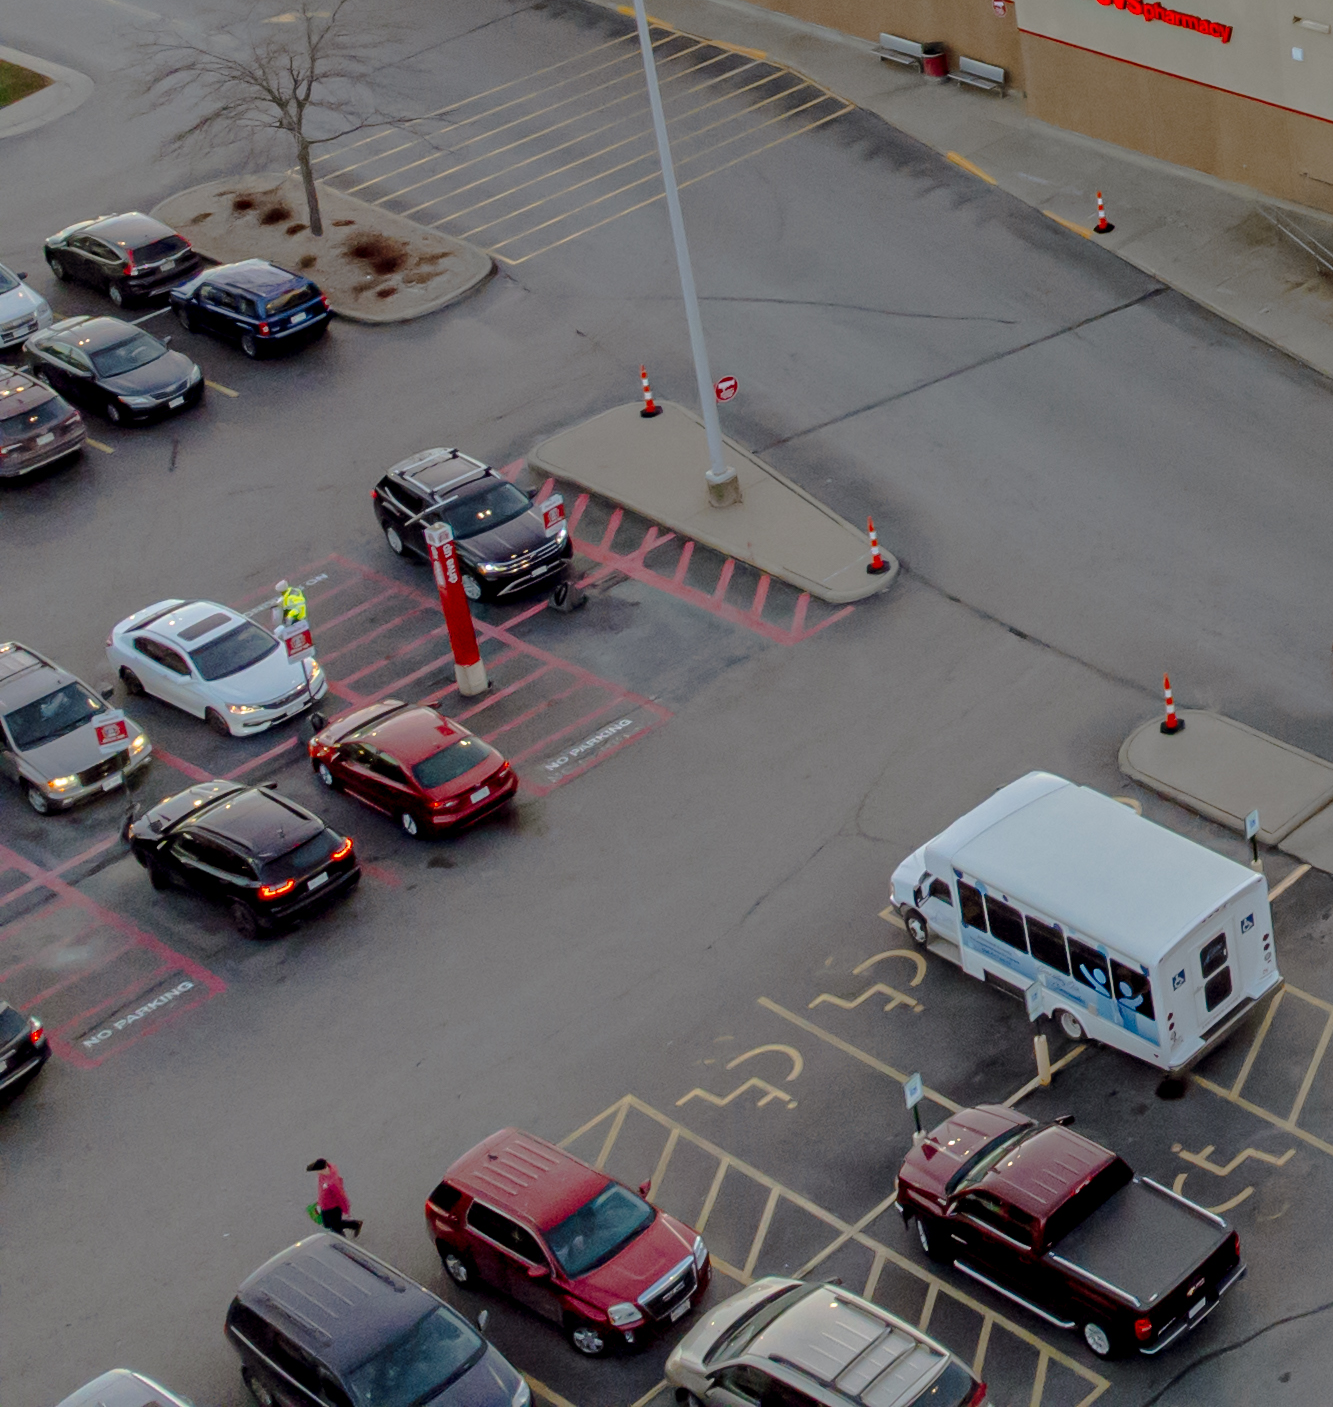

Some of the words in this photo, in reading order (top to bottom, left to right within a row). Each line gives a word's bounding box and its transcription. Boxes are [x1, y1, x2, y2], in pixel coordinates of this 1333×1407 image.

[1143, 2, 1233, 44] pharmacy
[545, 756, 569, 771] NO
[569, 719, 633, 757] PARKING
[83, 1029, 113, 1048] NO
[113, 980, 194, 1030] PARKING
